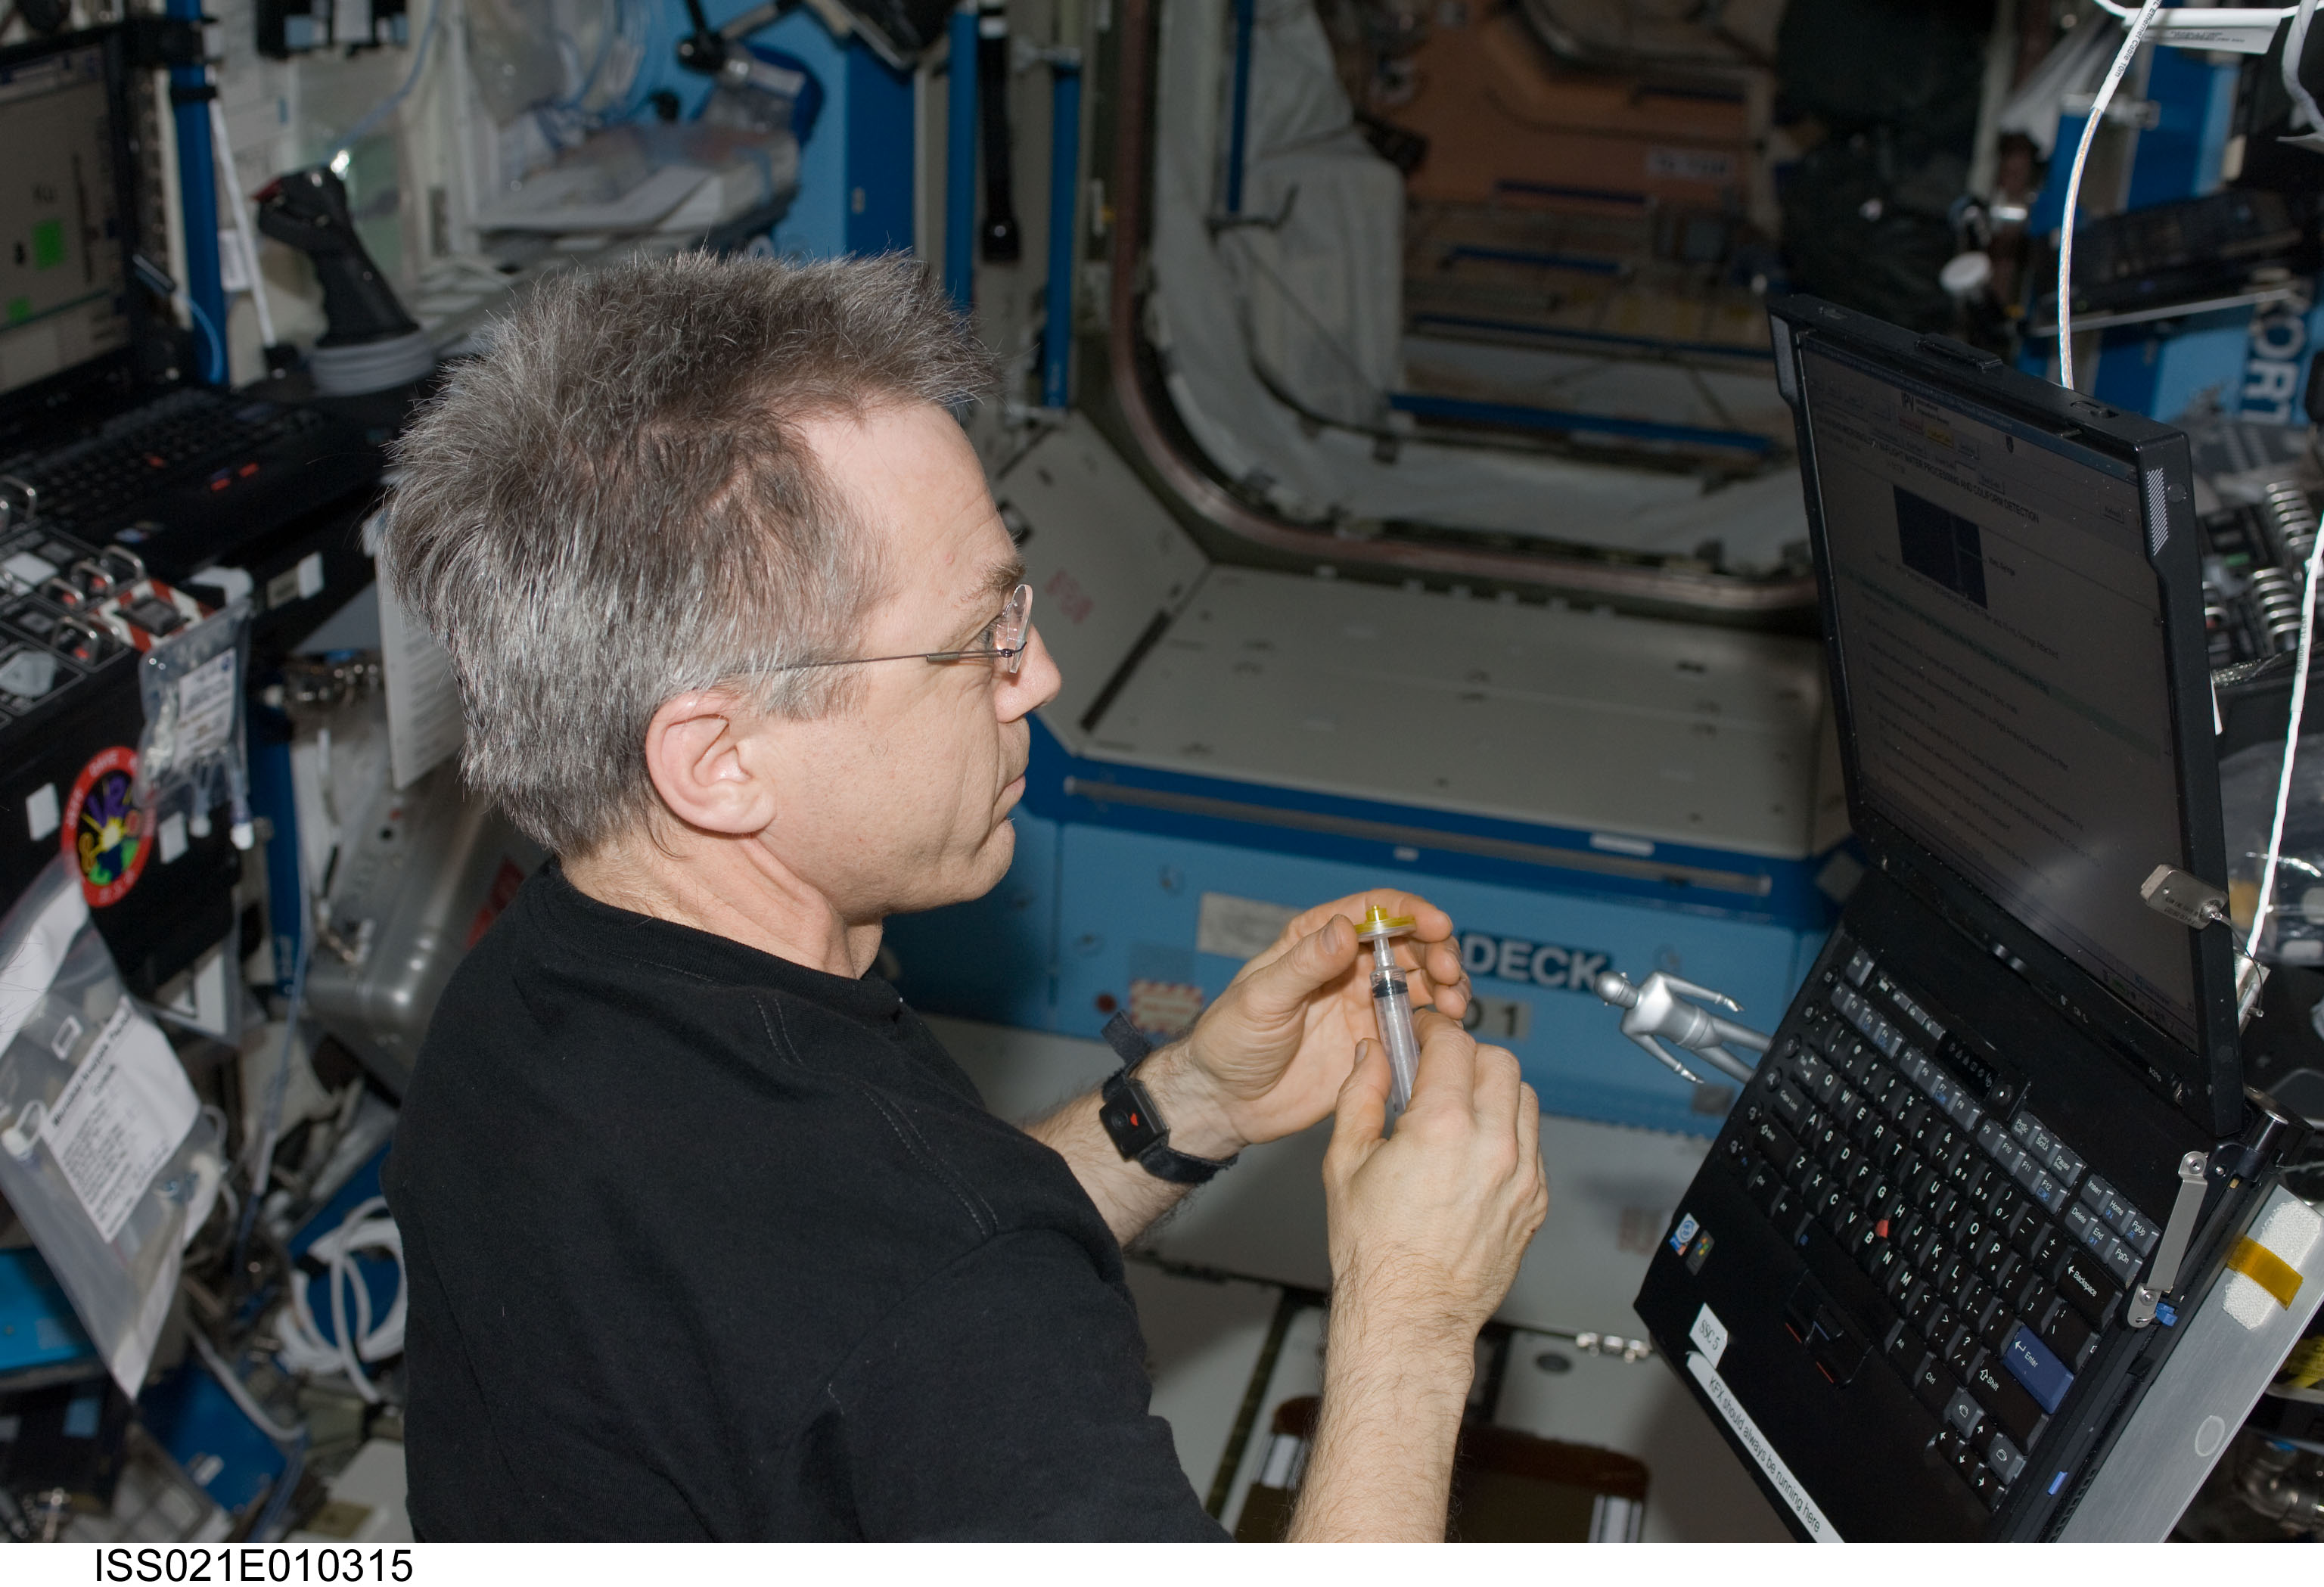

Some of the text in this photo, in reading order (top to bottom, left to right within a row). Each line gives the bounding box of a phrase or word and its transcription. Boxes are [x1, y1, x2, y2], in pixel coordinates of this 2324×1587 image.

[2136, 8, 2157, 39] Ethernet
[2124, 39, 2139, 61] Cable
[2114, 62, 2127, 77] 10m
[2003, 498, 2040, 524] DETECTION
[1462, 933, 1608, 992] DECK
[1904, 1051, 1912, 1061] F5
[1922, 1067, 1929, 1076] F6
[1824, 1073, 1833, 1086] Q
[1939, 1083, 1947, 1092] F7
[1841, 1089, 1852, 1104] W
[1957, 1100, 1965, 1110] F8
[1808, 1113, 1816, 1126] A
[1856, 1107, 1866, 1120] E
[1825, 1130, 1834, 1142] S
[1874, 1125, 1884, 1138] R
[1983, 1125, 1990, 1134] F9
[1841, 1148, 1850, 1160] D
[1893, 1143, 1902, 1156] T
[2002, 1143, 2012, 1154] F10
[1796, 1157, 1806, 1169] Z
[1912, 1161, 1922, 1175] Y
[2021, 1160, 2031, 1172] F11
[2056, 1156, 2071, 1171] Pause
[1858, 1166, 1869, 1177] F
[1813, 1173, 1822, 1187] X
[2041, 1179, 2052, 1191] F12
[1877, 1186, 1887, 1199] G
[1930, 1180, 1940, 1194] U
[2088, 1181, 2102, 1196] Insert
[1829, 1193, 1839, 1205] C
[1895, 1203, 1906, 1218] H
[1949, 1200, 1957, 1212] I
[2109, 1200, 2124, 1216] Home
[1847, 1212, 1857, 1224] V
[2071, 1207, 2087, 1224] Delete
[1913, 1225, 1922, 1236] J
[1970, 1222, 1980, 1235] O
[2093, 1228, 2104, 1241] End
[2131, 1220, 2146, 1237] PgUp
[1864, 1231, 1875, 1244] B
[1931, 1244, 1942, 1258] K
[1990, 1242, 2001, 1253] P
[1882, 1250, 1893, 1265] N
[2115, 1248, 2130, 1265] PgDn
[1952, 1266, 1959, 1278] L
[1900, 1272, 1912, 1286] M
[2073, 1271, 2099, 1297] Backspace
[1699, 1319, 1720, 1350] SSC 5
[2024, 1352, 2039, 1368] Enter
[1926, 1372, 1937, 1384] Ctrl
[1987, 1376, 1999, 1392] Shift
[1708, 1376, 1821, 1533] KFX should always be running here
